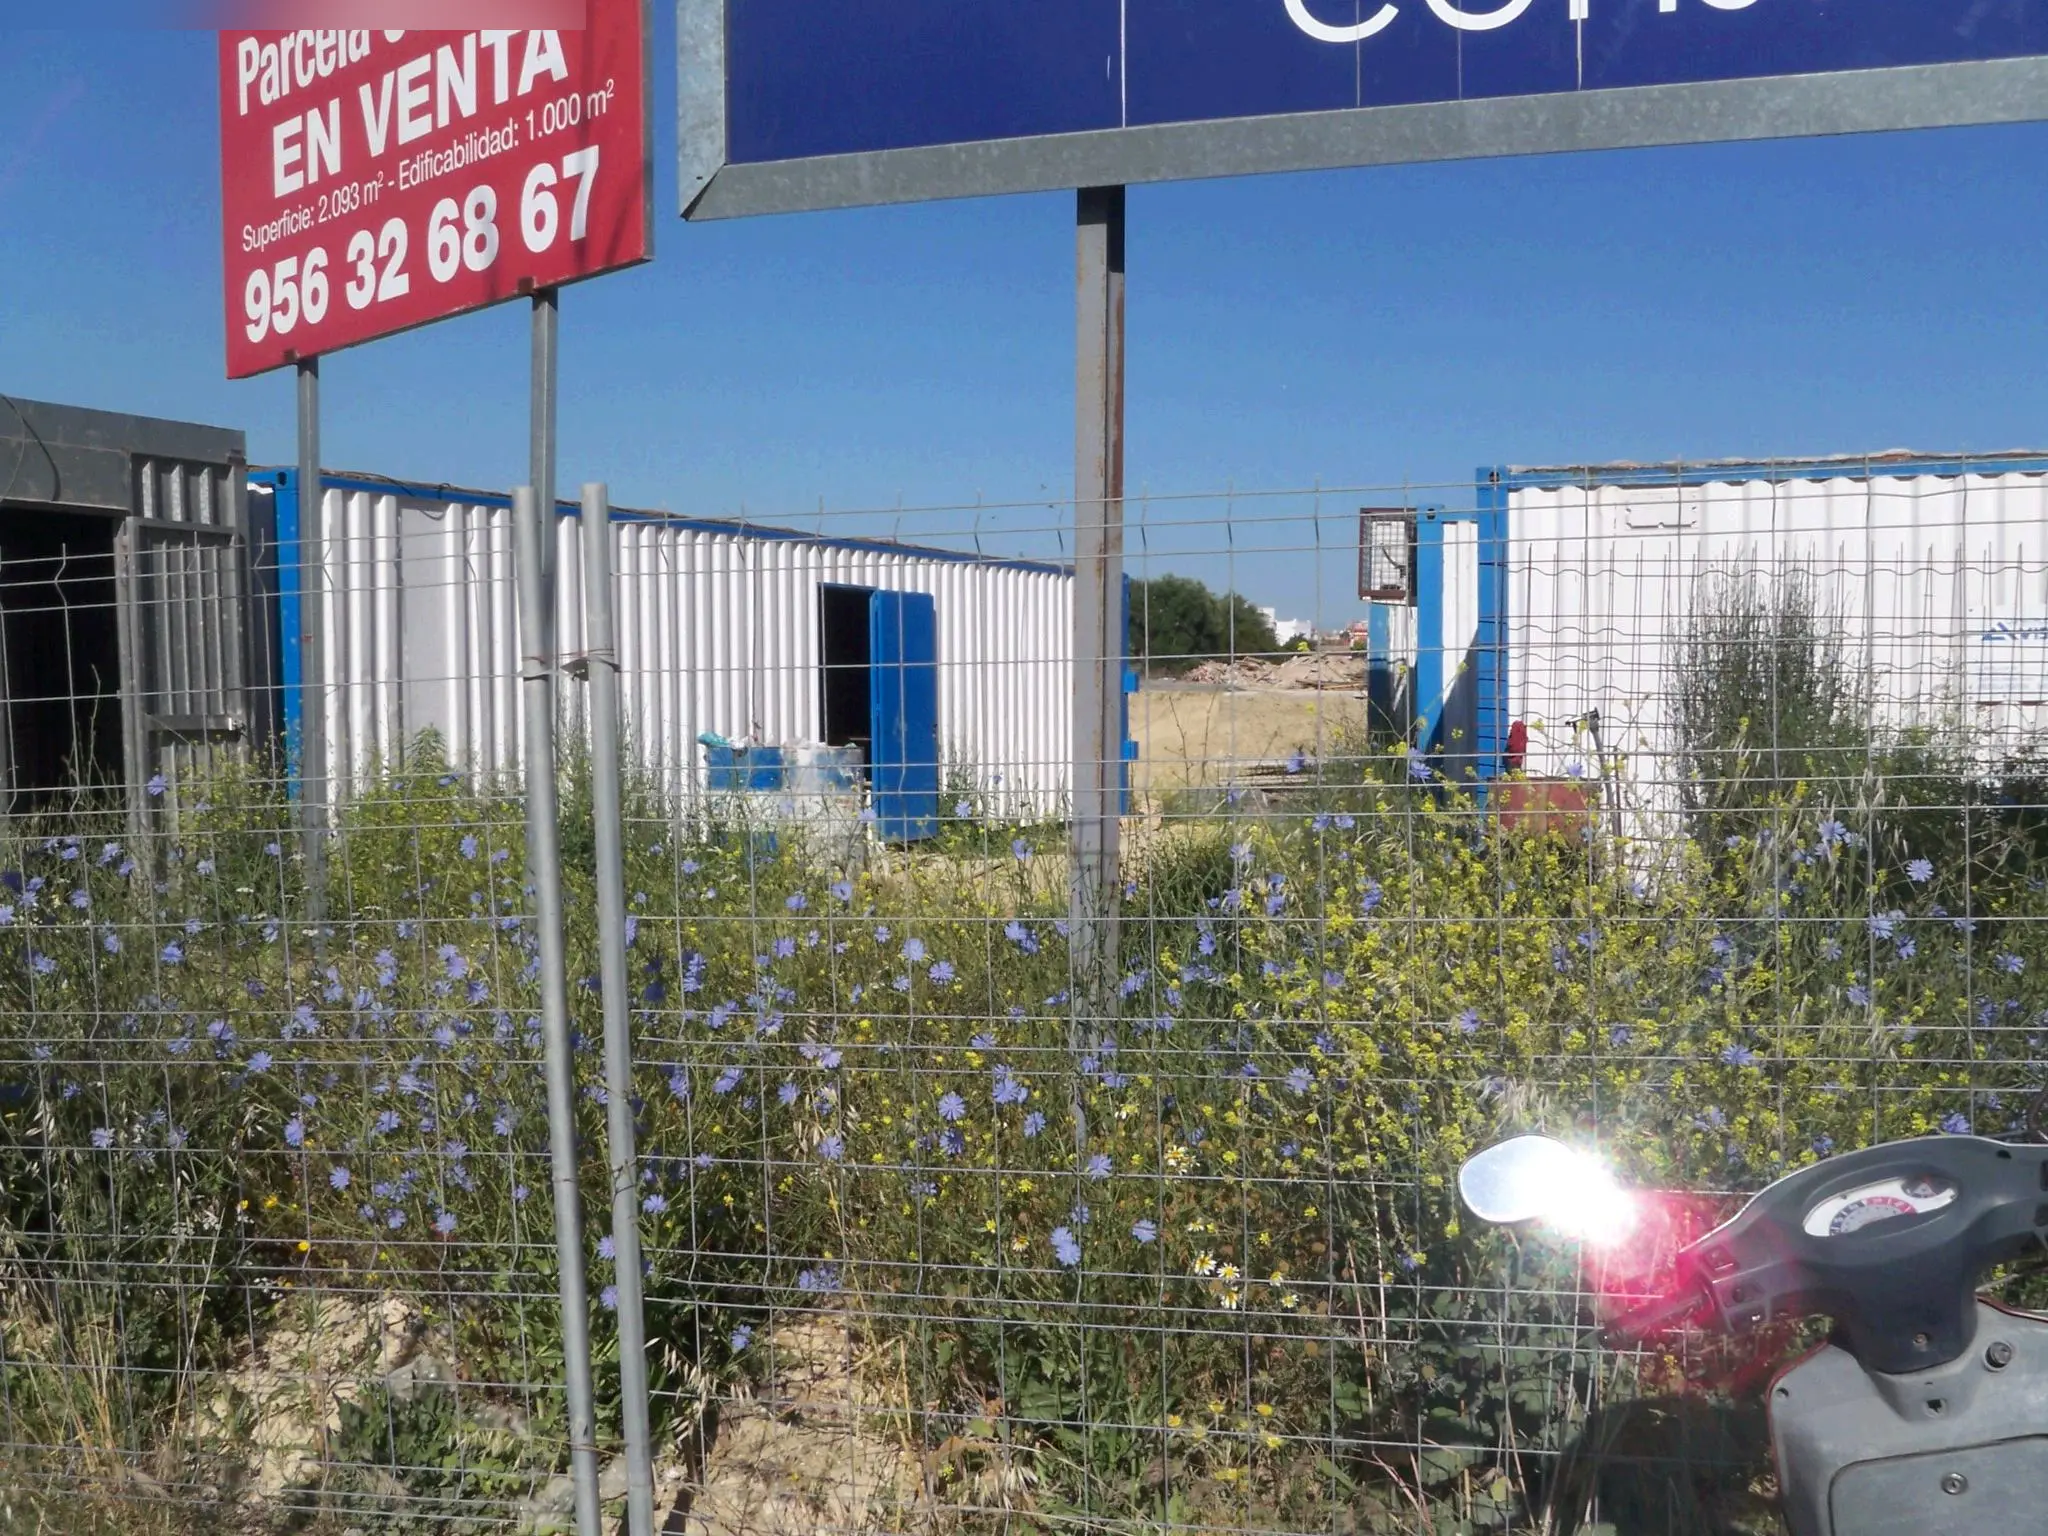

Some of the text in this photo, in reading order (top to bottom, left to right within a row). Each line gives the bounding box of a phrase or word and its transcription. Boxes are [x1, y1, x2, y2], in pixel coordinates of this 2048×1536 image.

[242, 206, 315, 252] Superficie:
[318, 182, 360, 223] 2.093
[399, 117, 519, 190] Edificabilidad:
[525, 93, 581, 141] 1.000
[273, 30, 569, 198] EN VENTA
[244, 145, 600, 343] 956 32 68 67
